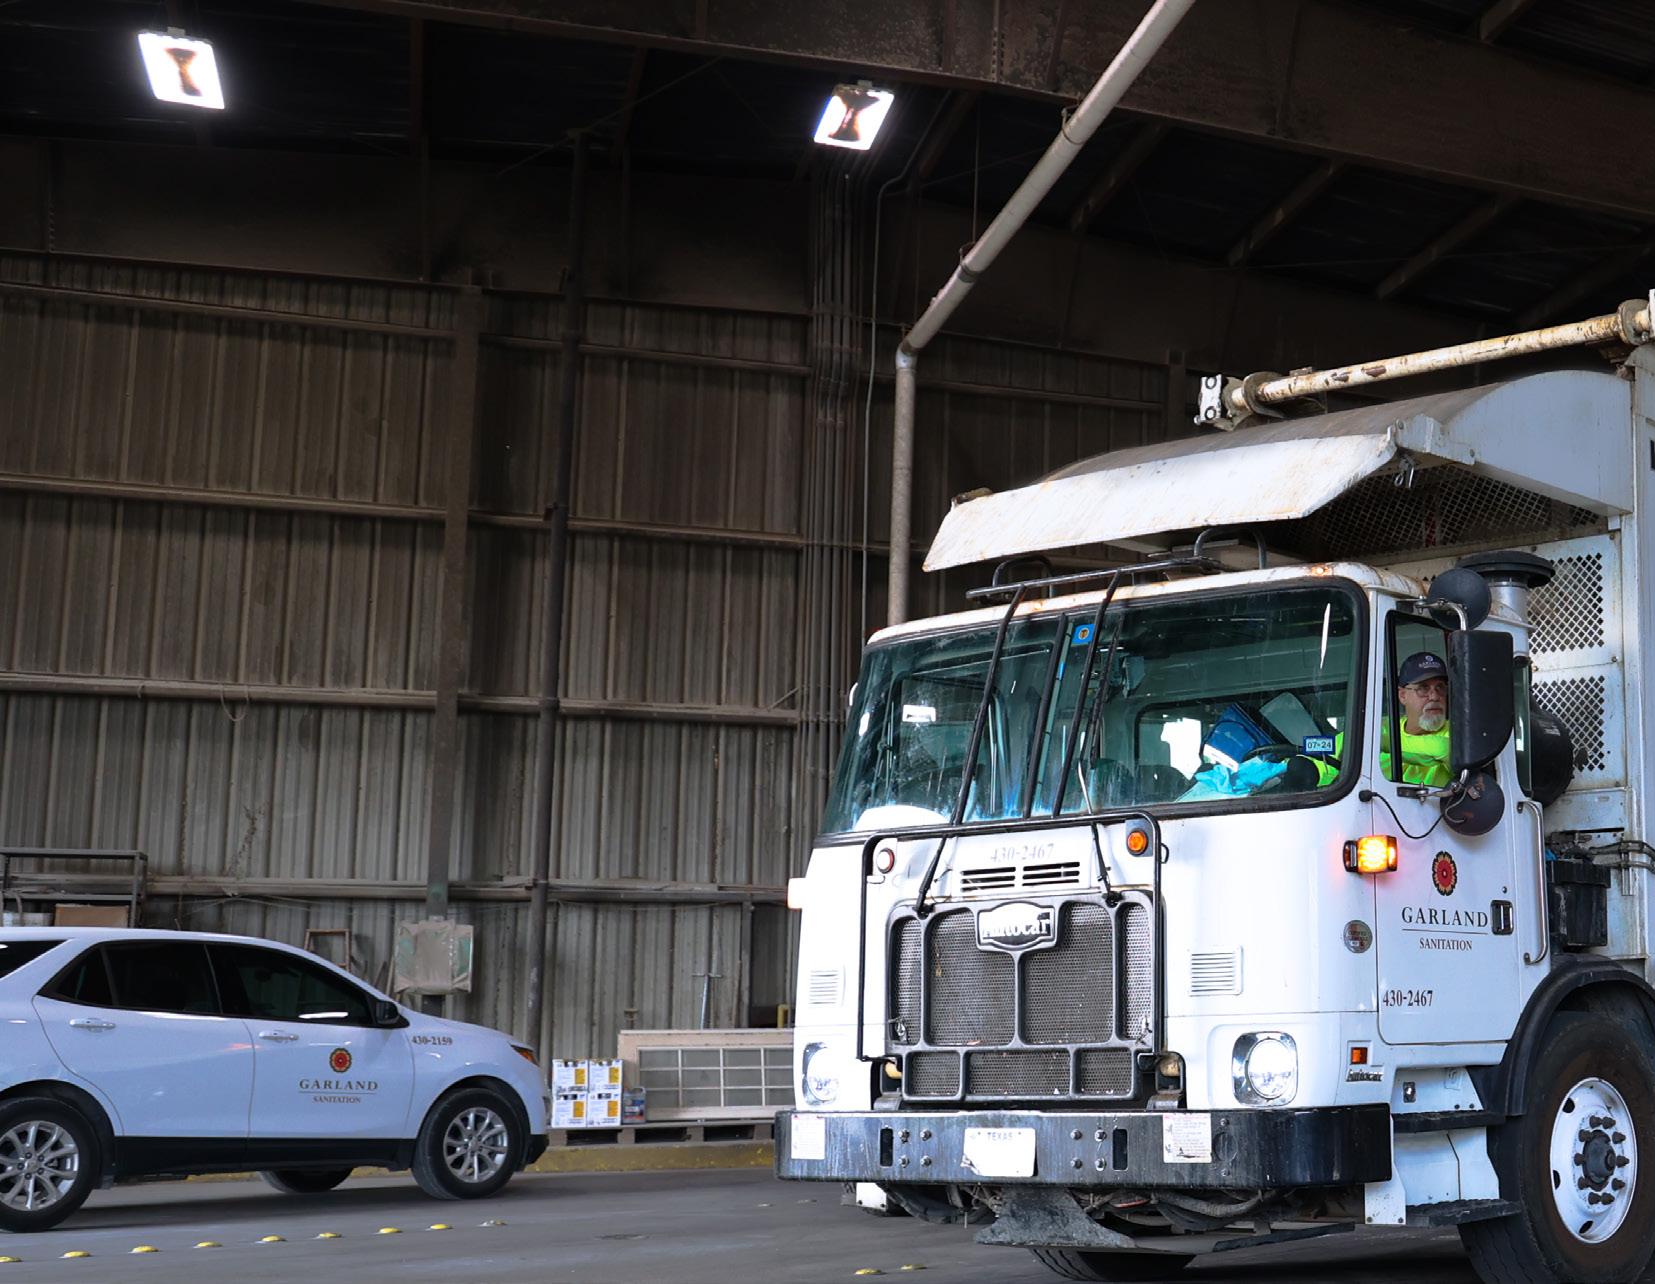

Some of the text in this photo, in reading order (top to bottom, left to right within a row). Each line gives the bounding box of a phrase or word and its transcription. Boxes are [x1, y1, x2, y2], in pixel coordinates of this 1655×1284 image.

[990, 843, 1054, 861] 430-2467
[1401, 906, 1488, 927] GARLAND
[1419, 937, 1473, 951] SANITATION
[1382, 989, 1433, 1007] 430-2467
[411, 1035, 453, 1046] 430-2159
[299, 1079, 379, 1091] GARLAND
[313, 1095, 362, 1104] SANITATION
